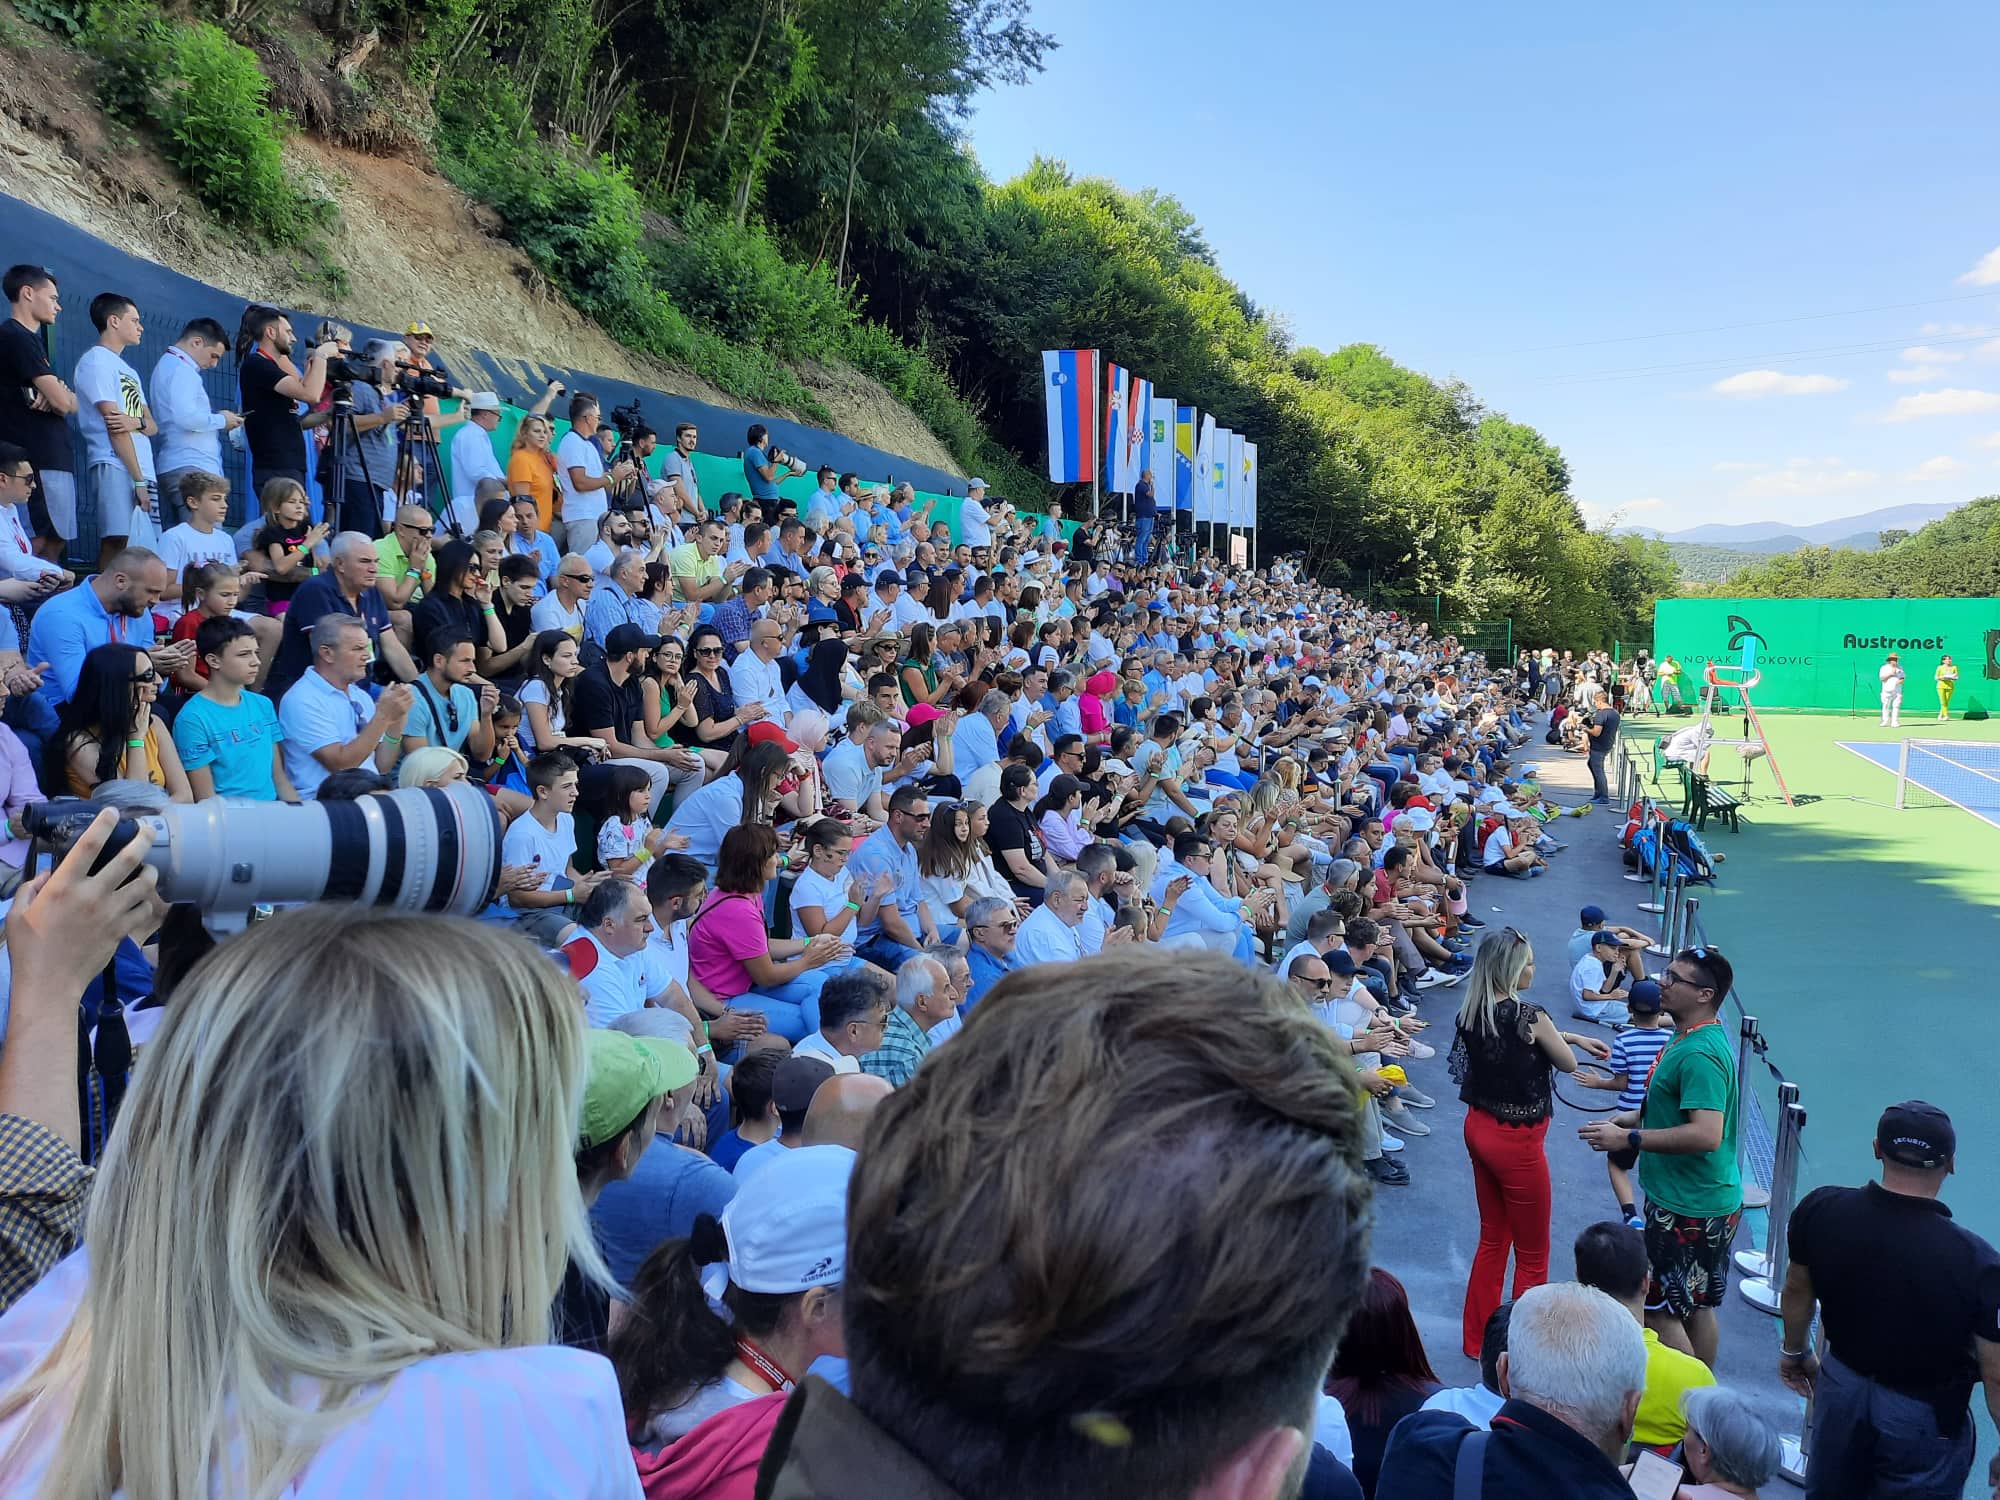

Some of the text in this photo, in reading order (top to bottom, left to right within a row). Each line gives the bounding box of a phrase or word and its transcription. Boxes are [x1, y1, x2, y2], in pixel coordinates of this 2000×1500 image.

[1843, 633, 1944, 649] Austronet
[1684, 655, 1813, 666] NOVAK OKOVIC
[1893, 1137, 1930, 1149] SECURITY
